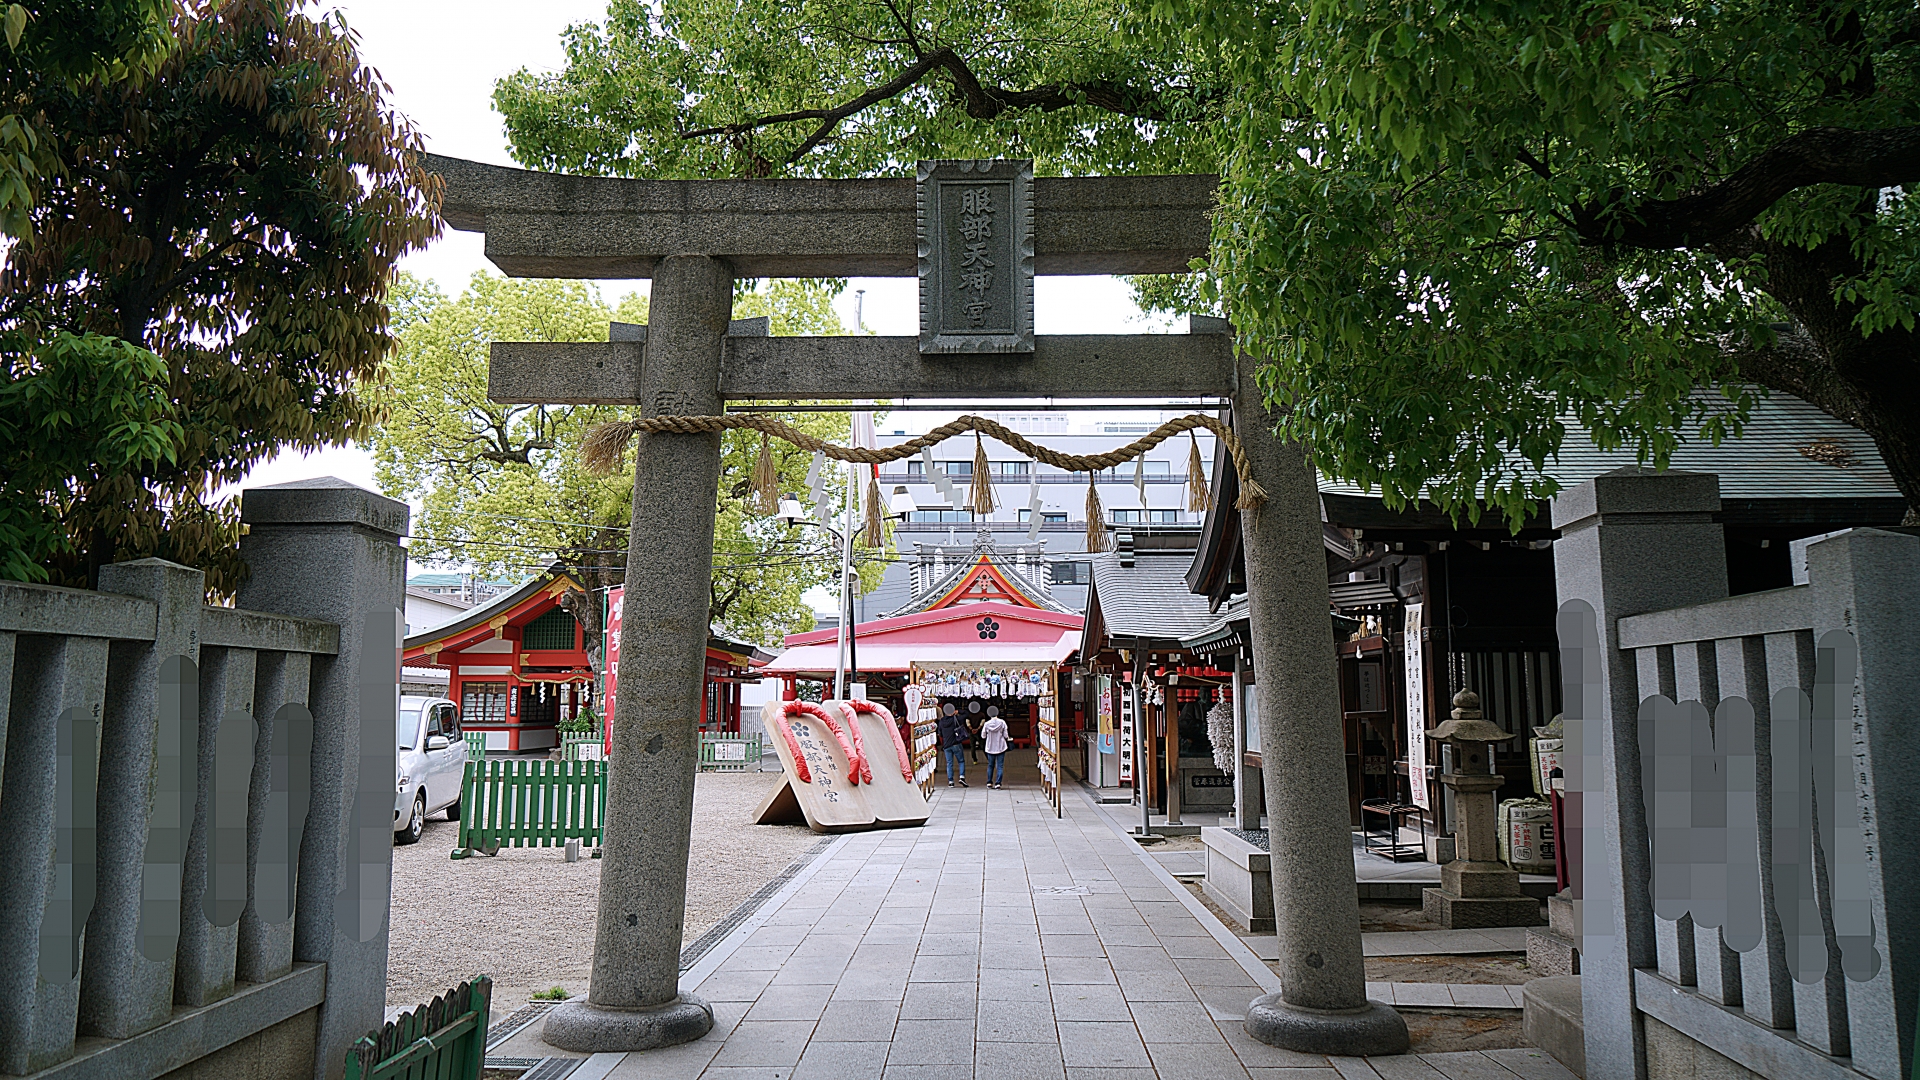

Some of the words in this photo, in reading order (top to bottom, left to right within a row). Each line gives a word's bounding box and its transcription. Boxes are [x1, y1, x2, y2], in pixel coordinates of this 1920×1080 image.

[958, 186, 996, 328] 服部天神宮
[1102, 686, 1113, 747] おみくじ
[800, 739, 839, 803] 服部天神宮
[818, 740, 838, 771] 足の神様
